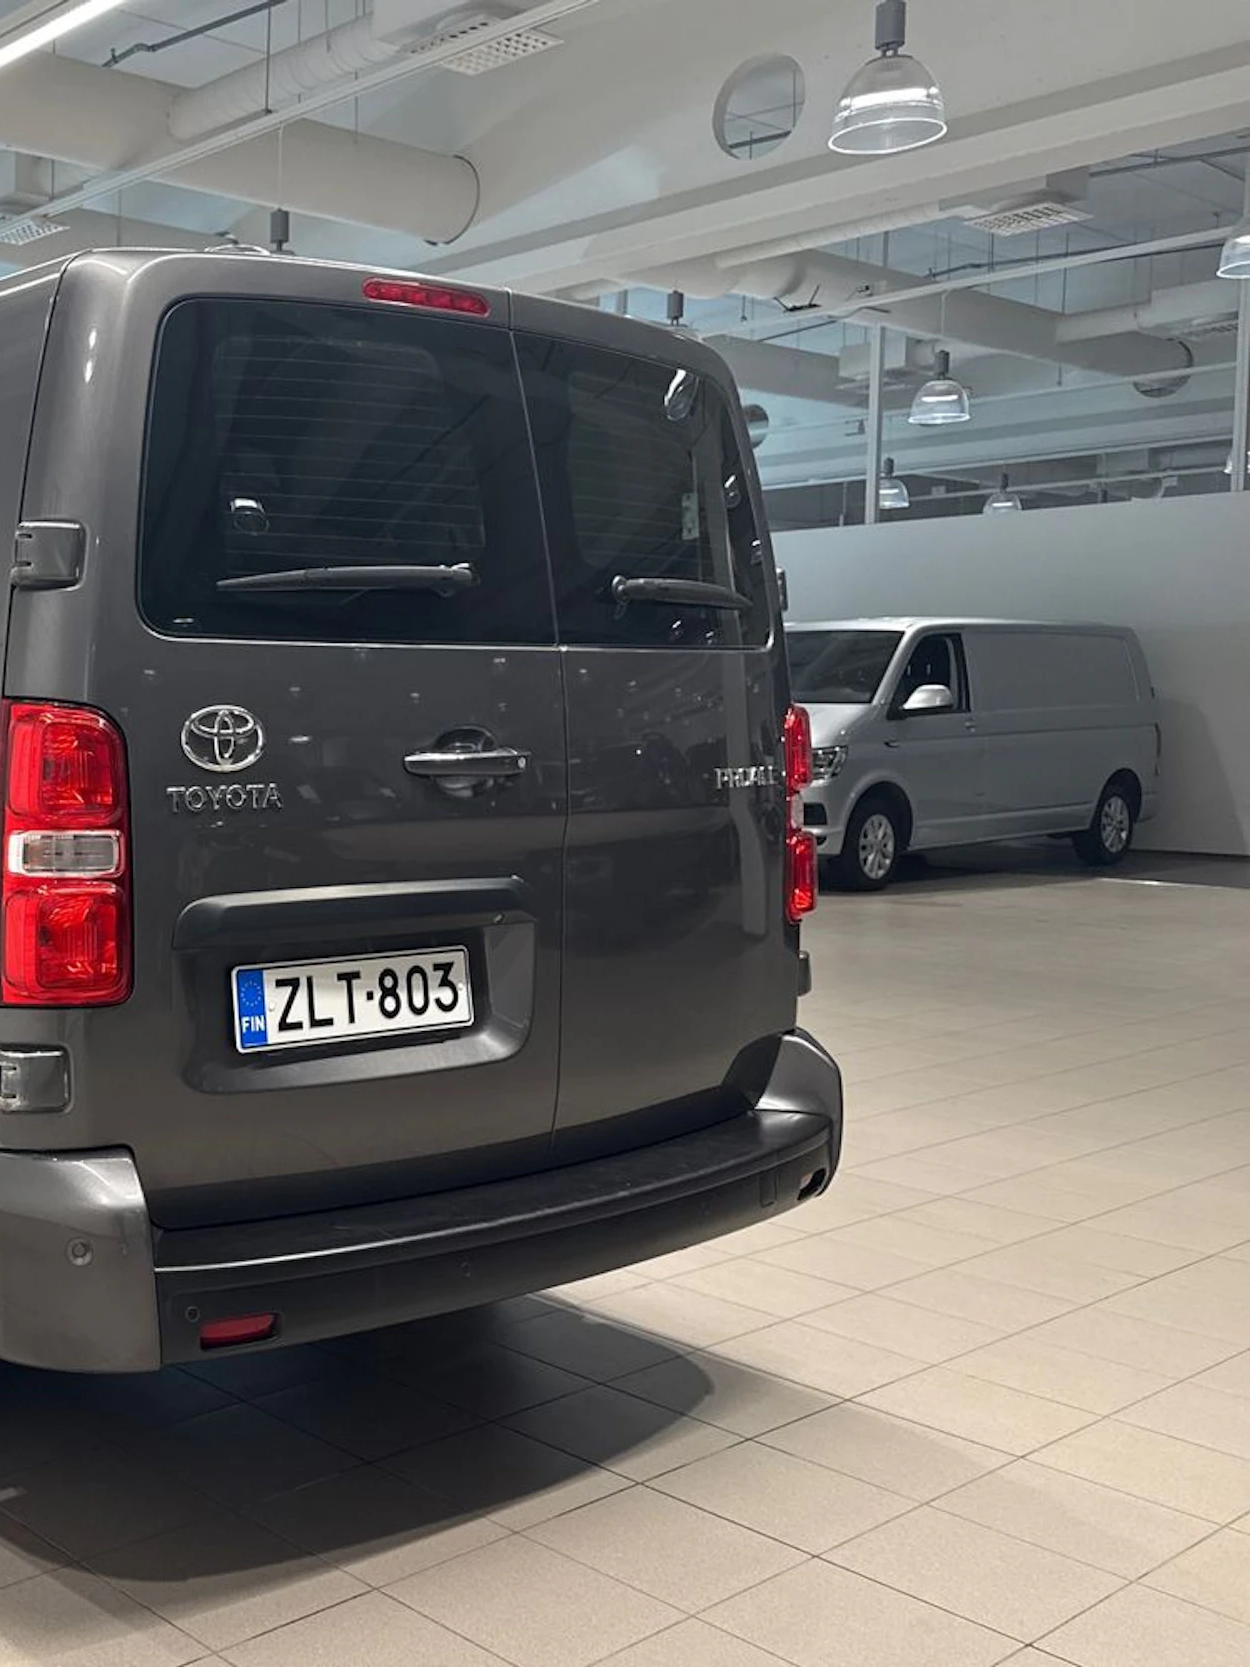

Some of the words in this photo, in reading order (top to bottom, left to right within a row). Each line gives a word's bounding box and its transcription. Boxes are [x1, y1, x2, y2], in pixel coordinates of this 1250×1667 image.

[166, 783, 283, 813] TOYOTA
[275, 961, 460, 1034] ZLT-803
[242, 1015, 266, 1033] FIN
